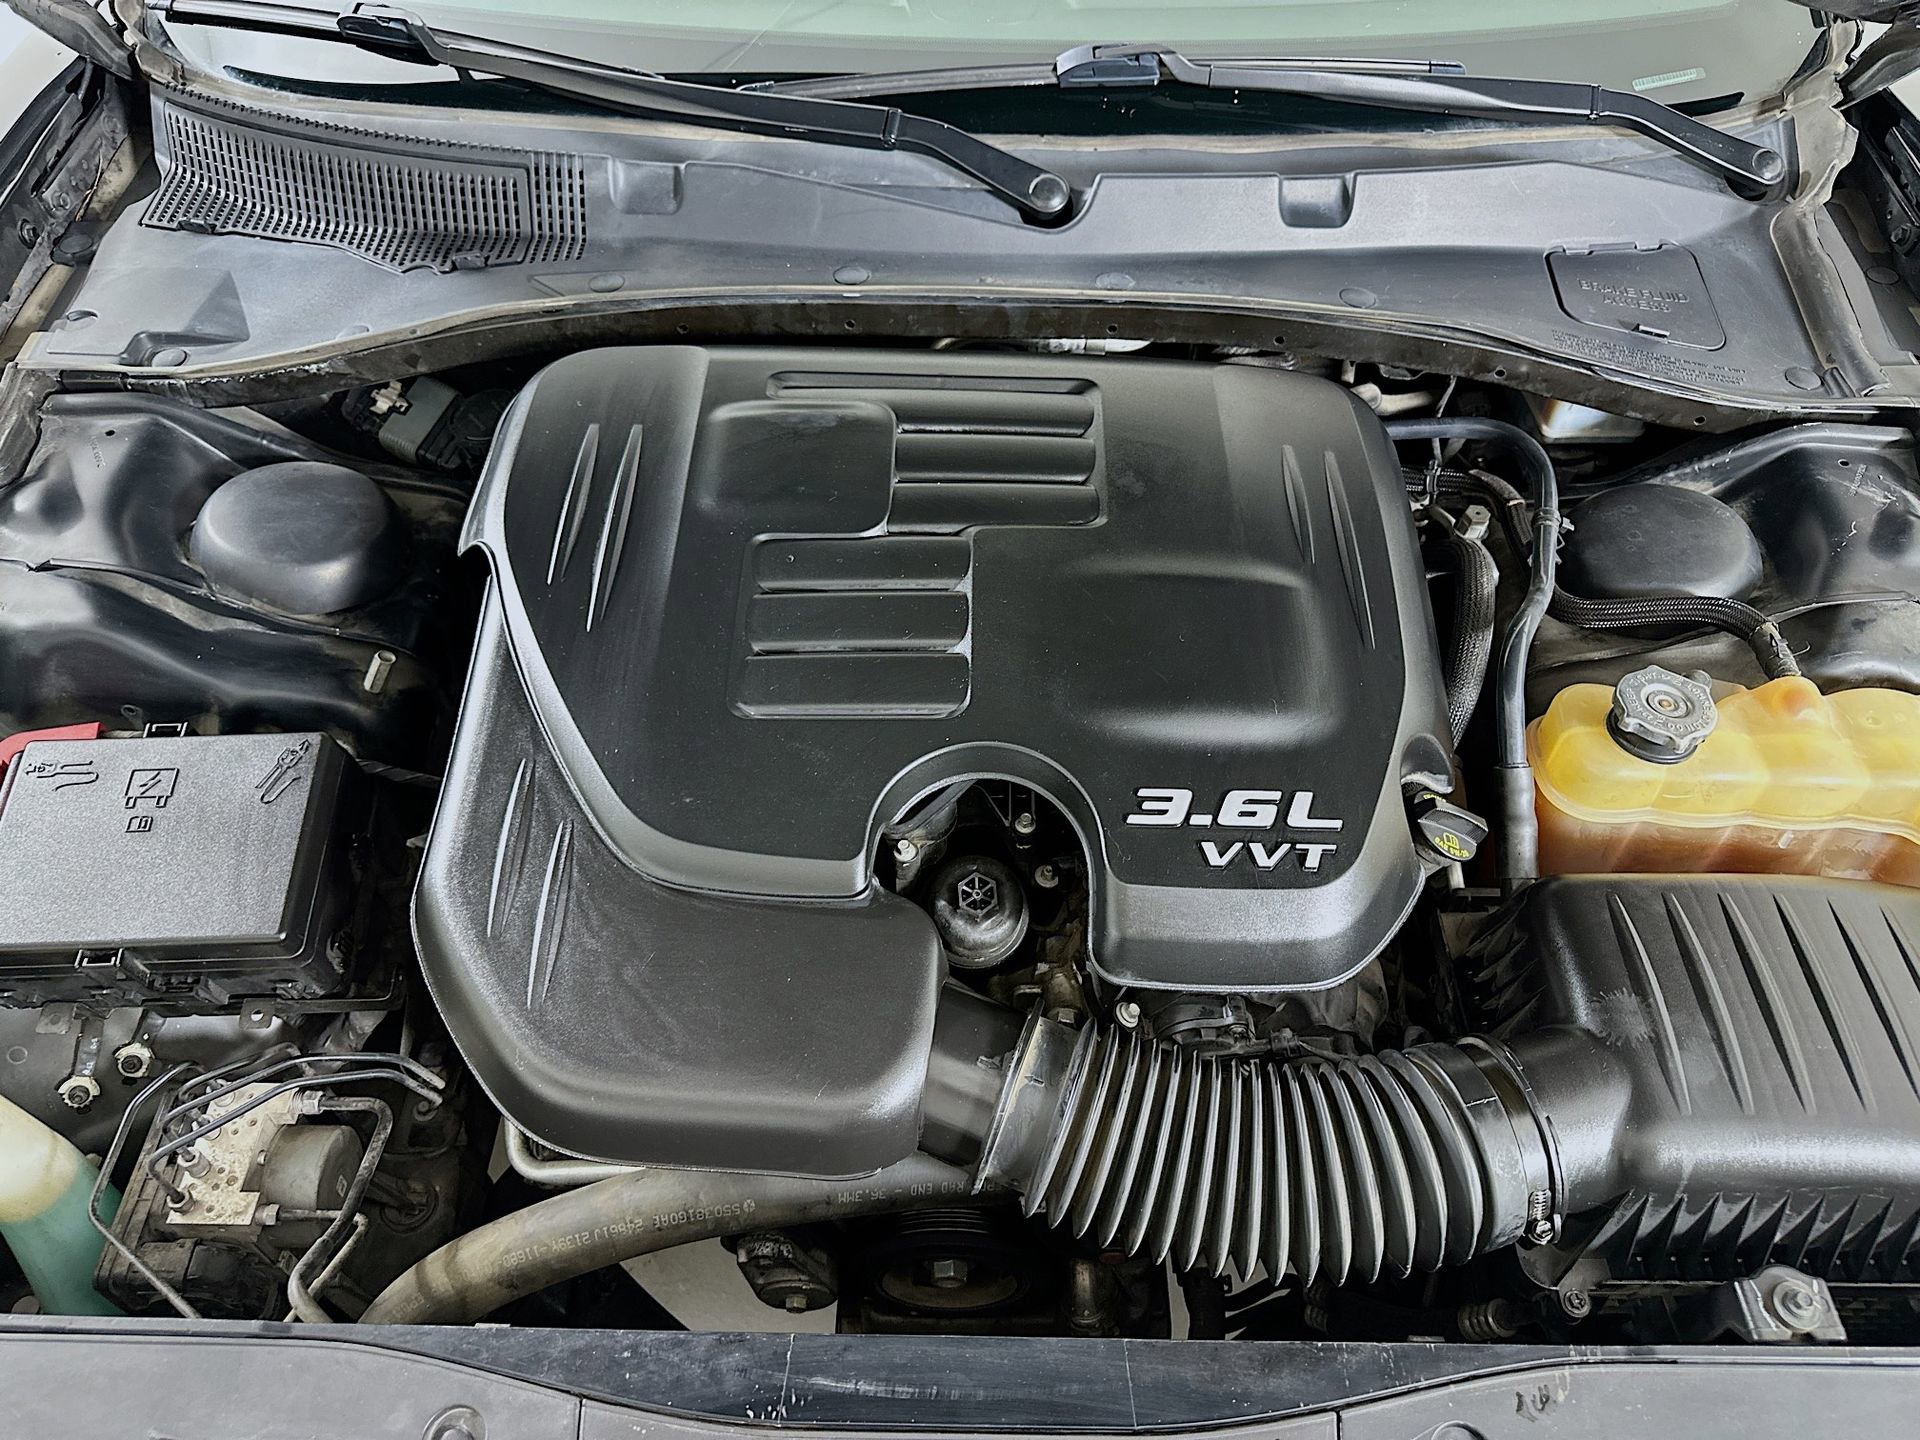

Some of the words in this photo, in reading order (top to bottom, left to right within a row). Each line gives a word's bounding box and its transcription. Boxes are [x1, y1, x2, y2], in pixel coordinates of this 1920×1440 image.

[1577, 279, 1638, 298] BRAKE
[1639, 288, 1690, 303] FLUID
[1602, 294, 1672, 313] ACCESS
[1125, 788, 1344, 832] 3.6L
[1199, 841, 1338, 872] VVT
[910, 1184, 933, 1196] END
[941, 1181, 965, 1193] RAD
